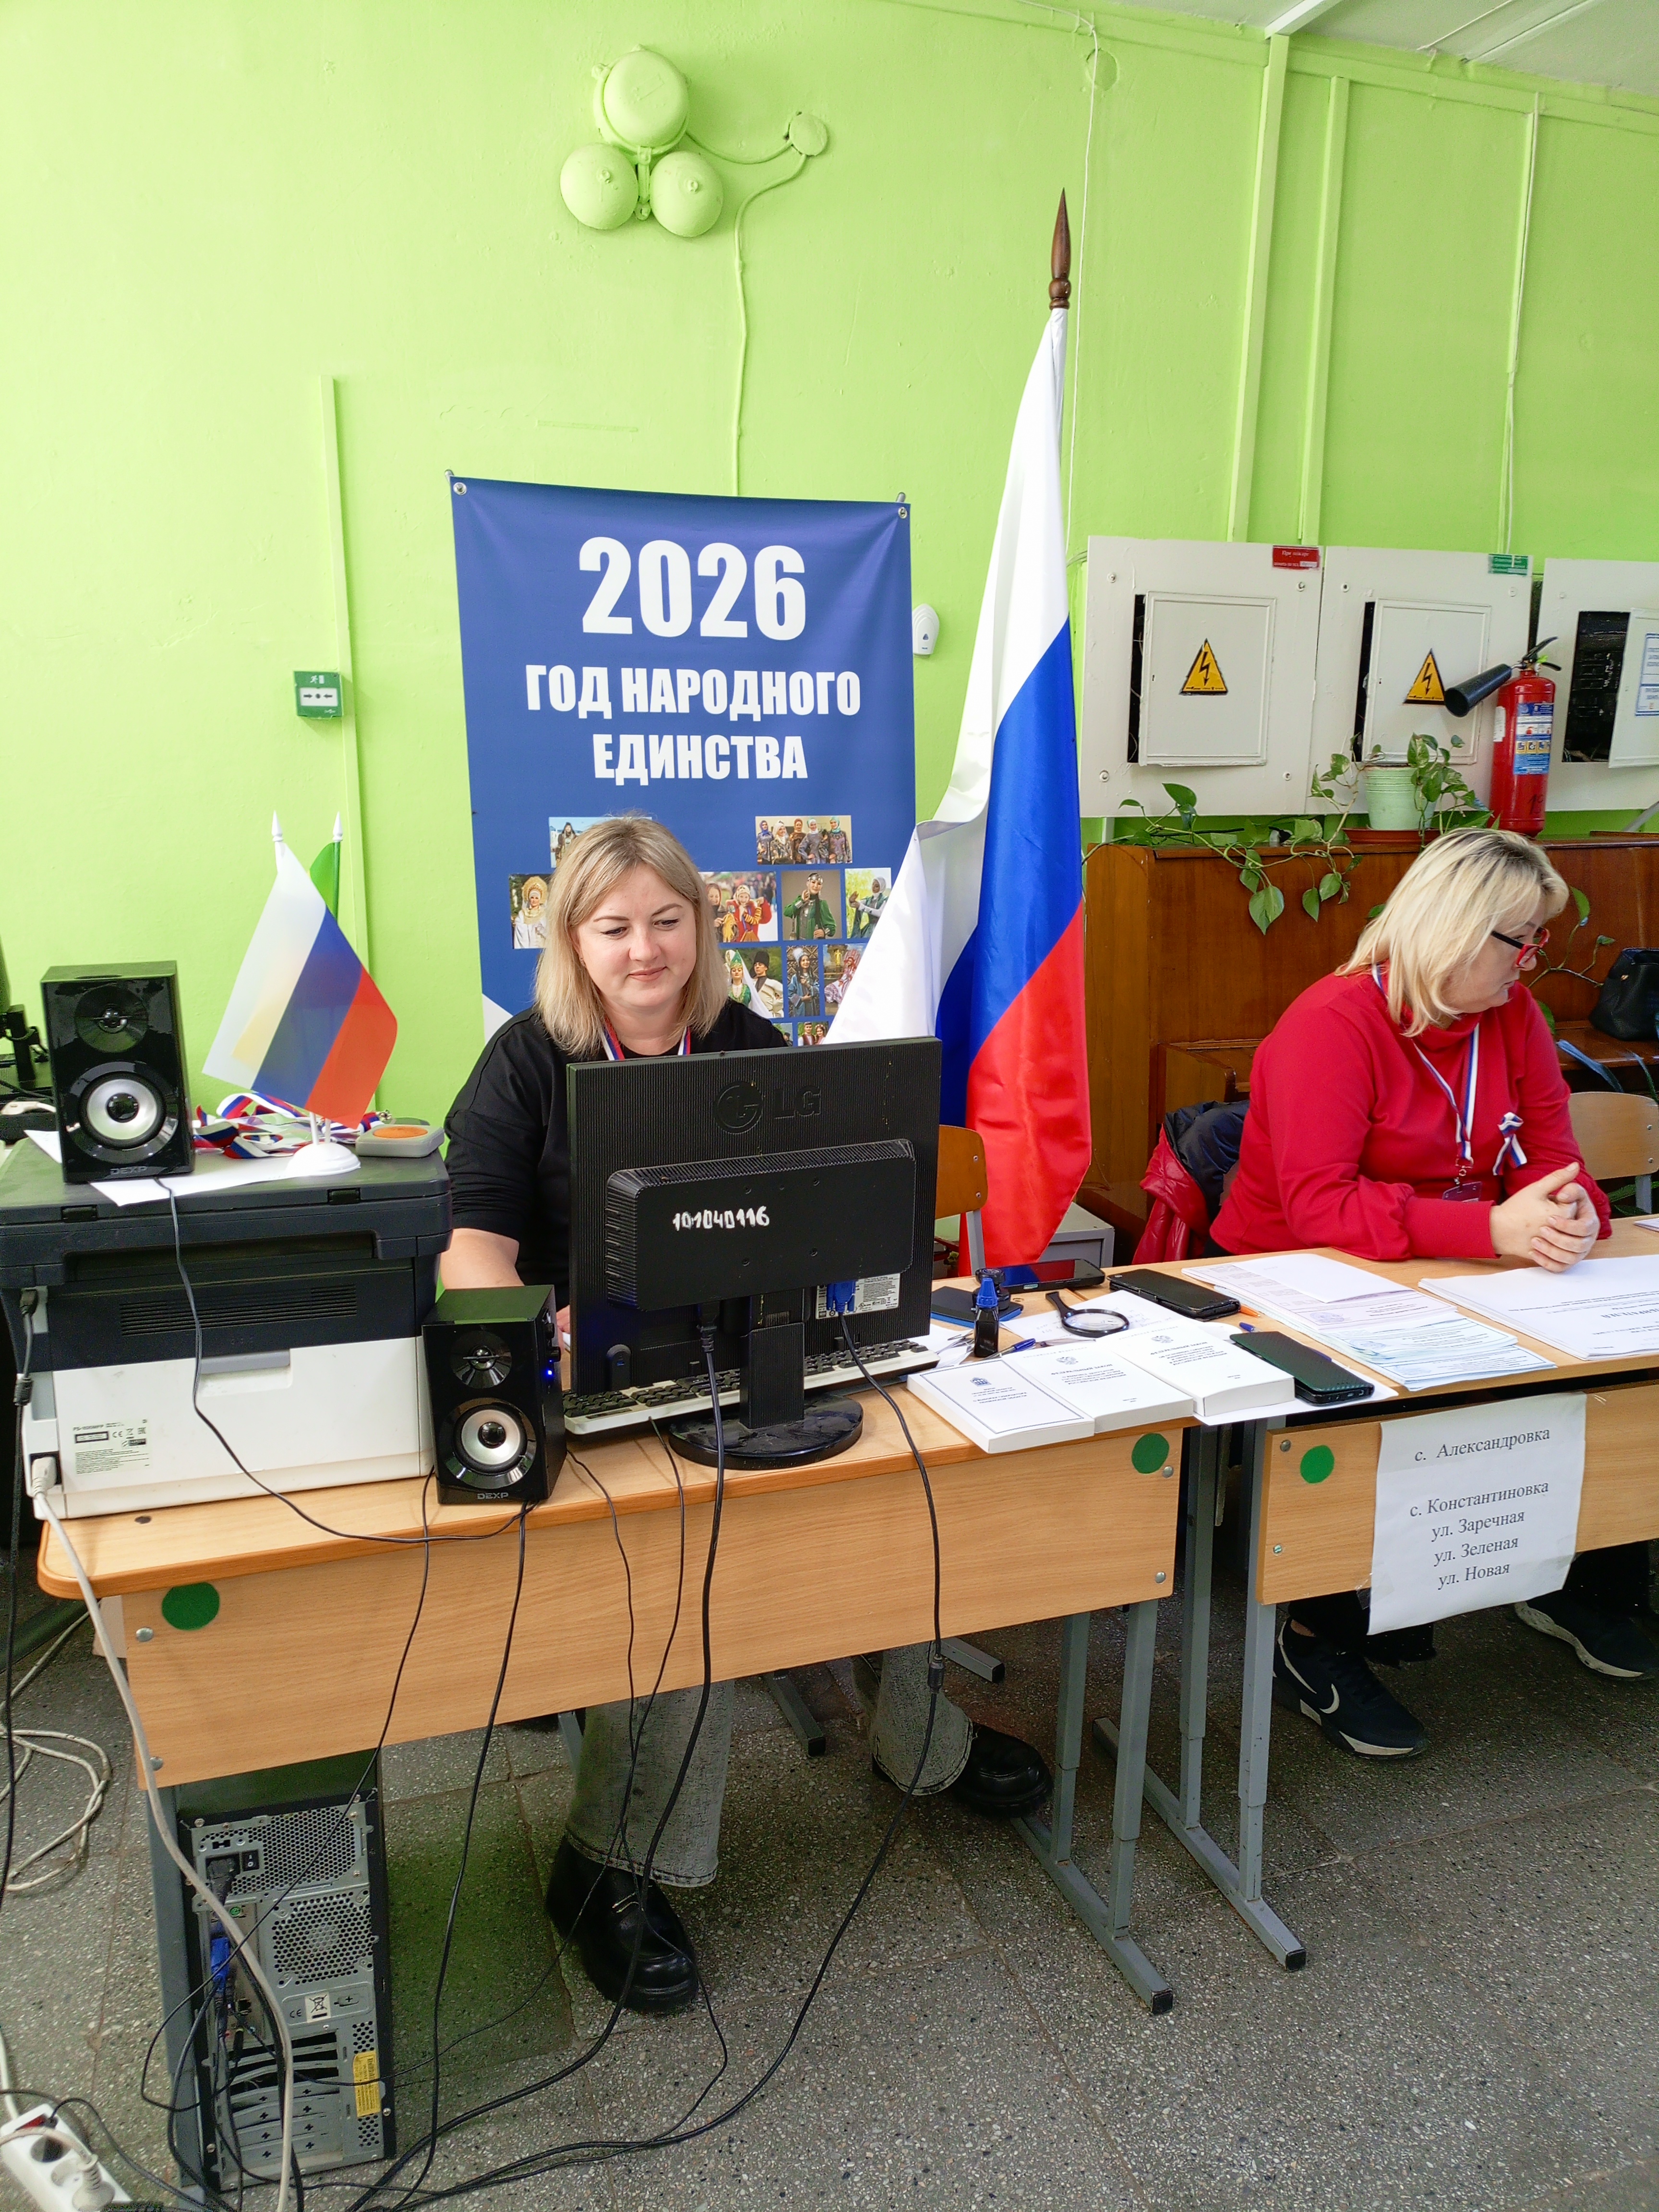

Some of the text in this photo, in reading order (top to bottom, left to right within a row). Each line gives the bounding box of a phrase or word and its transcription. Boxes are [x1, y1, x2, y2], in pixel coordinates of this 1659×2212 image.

[579, 536, 806, 640] 2026
[526, 664, 860, 721] ГОД НАРОДНОГО
[593, 733, 808, 786] ЕДИНСТВА
[773, 1085, 821, 1119] LG
[110, 1166, 148, 1175] DEXP
[673, 1205, 770, 1231] 101040116
[1414, 1429, 1550, 1462] с. Александровка
[1409, 1482, 1549, 1517] с. Константиновка
[1431, 1511, 1525, 1543] ул. Заречная
[1433, 1538, 1519, 1568] ул. Зеленая
[1437, 1563, 1510, 1591] ул. Новая
